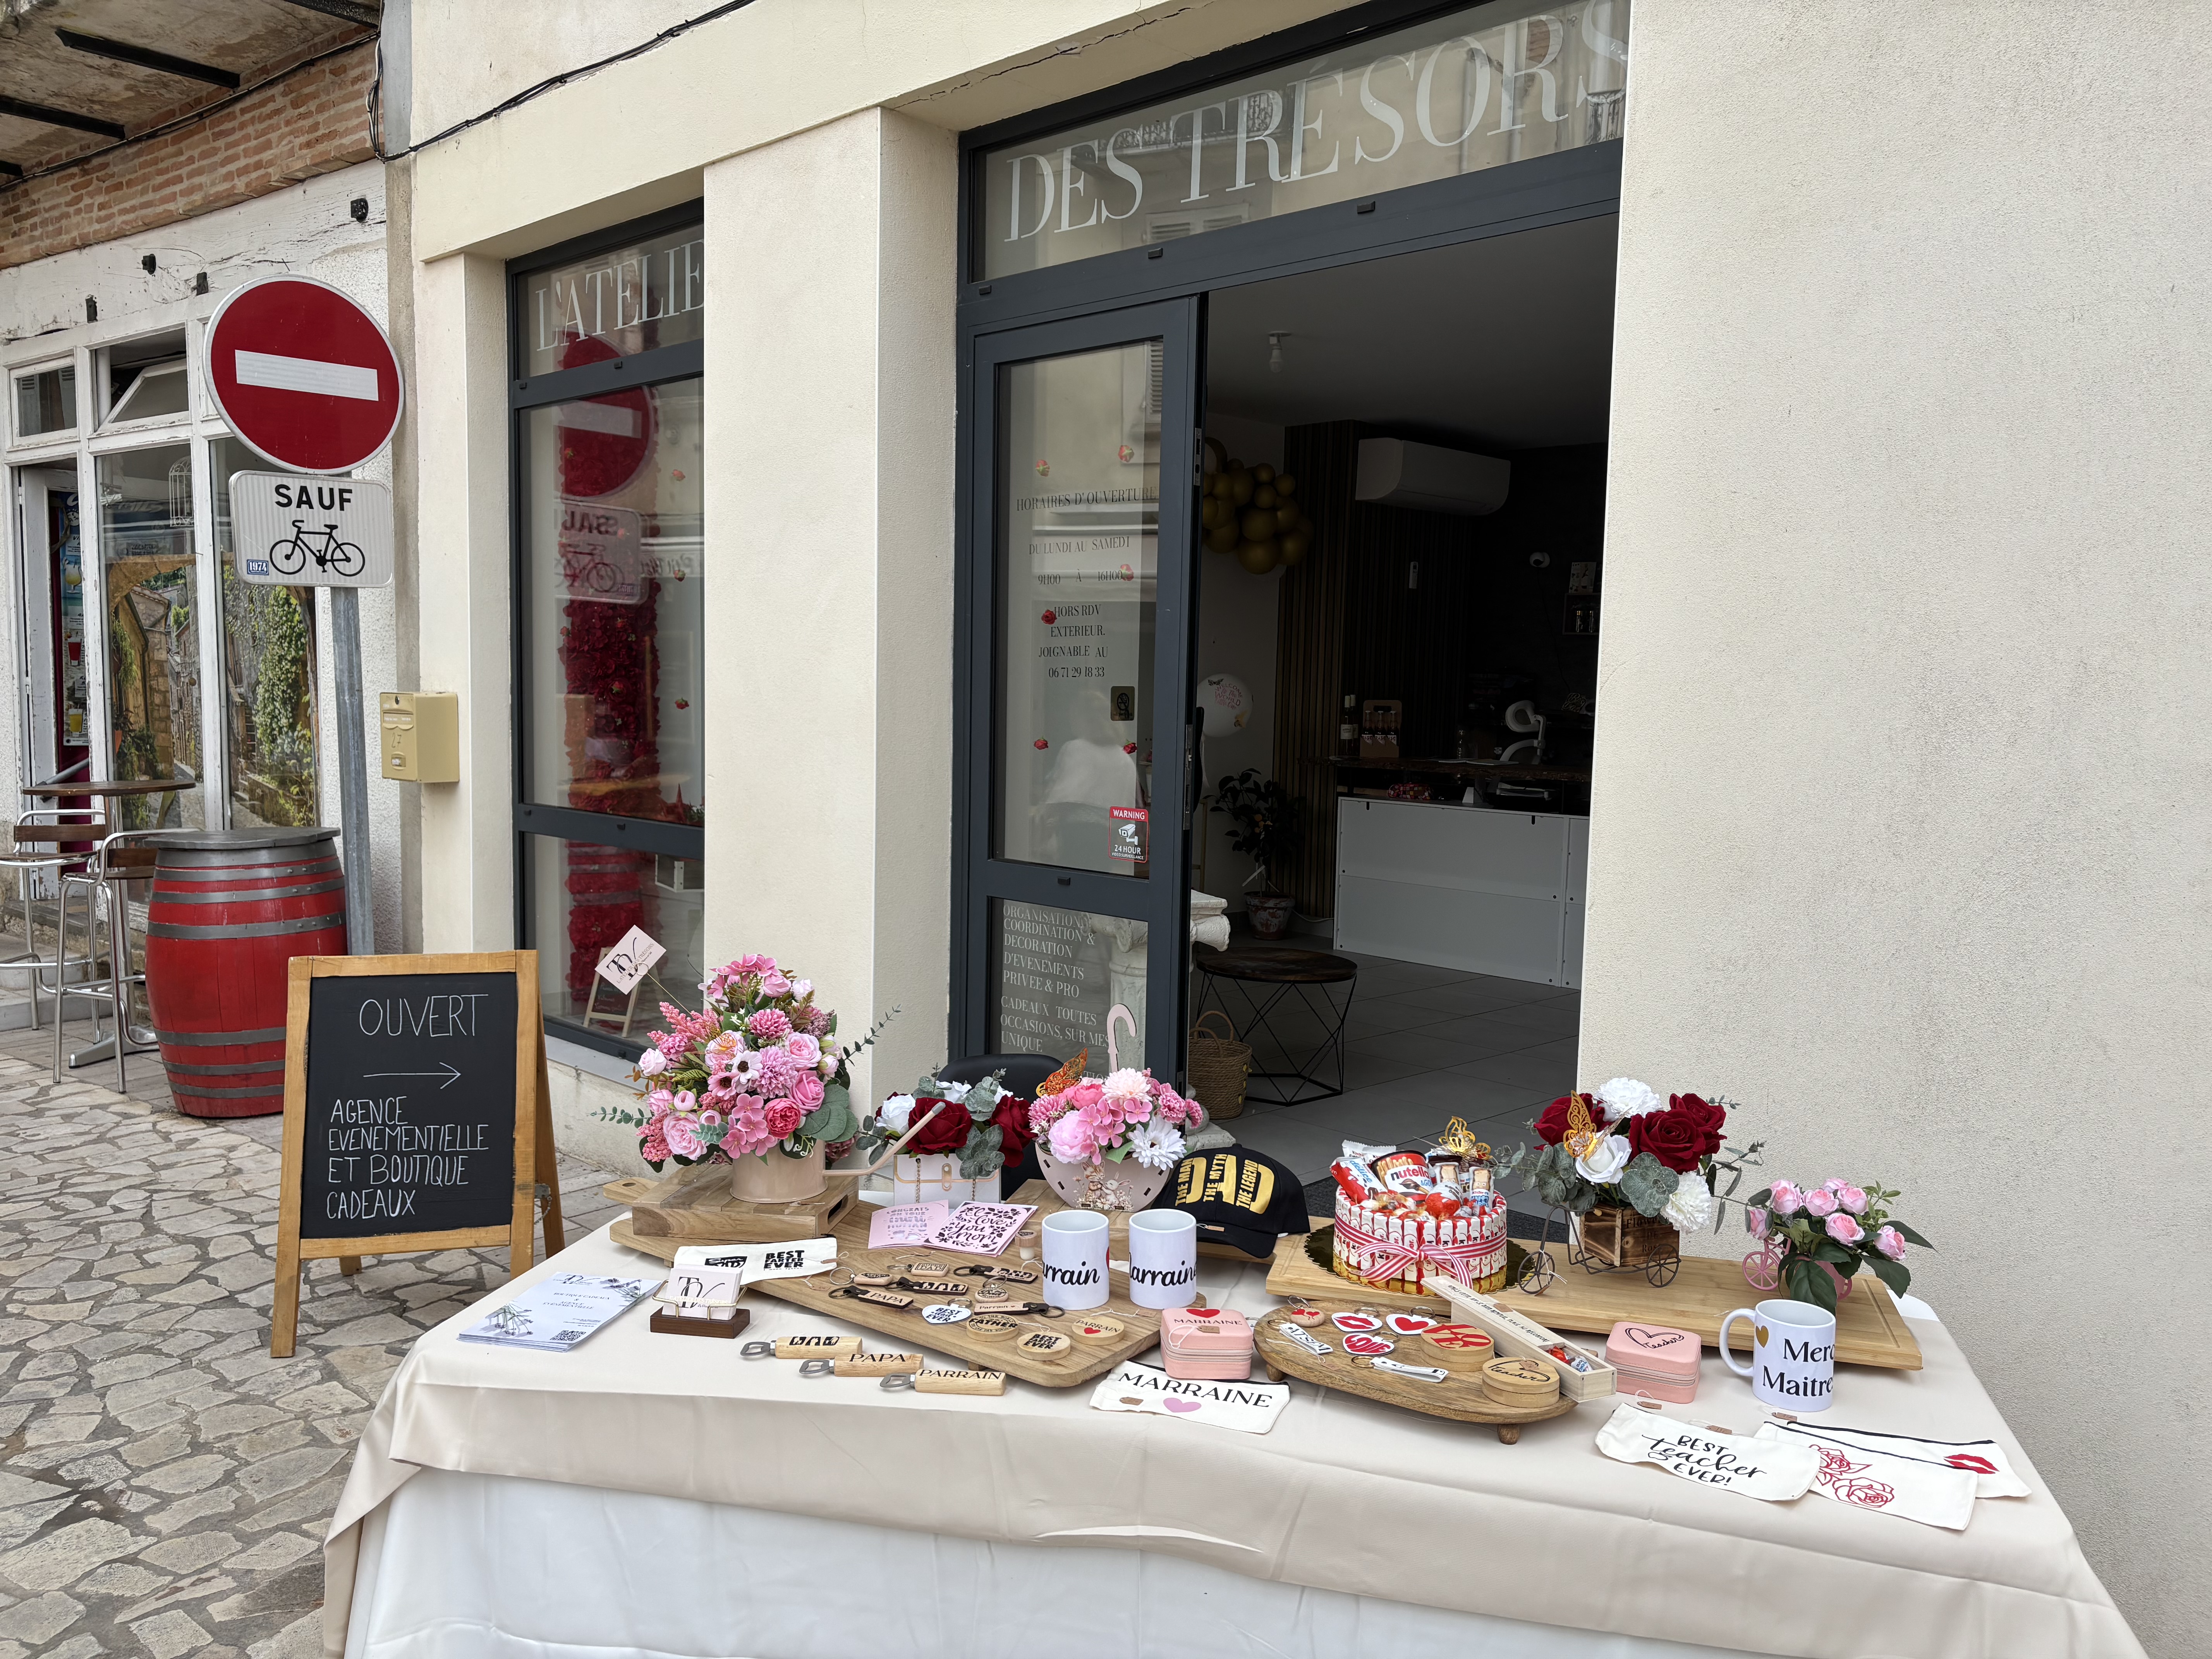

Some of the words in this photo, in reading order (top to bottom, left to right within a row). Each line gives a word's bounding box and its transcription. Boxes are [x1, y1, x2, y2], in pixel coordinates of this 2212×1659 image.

[1005, 128, 1143, 242] DES
[275, 484, 352, 511] SAUF
[1017, 494, 1070, 511] HORAIRES
[1029, 543, 1041, 555] DU
[1044, 542, 1071, 554] LUNDI
[1075, 541, 1087, 552] AU
[1092, 536, 1129, 550] SAMEDI
[1038, 574, 1060, 585] 9H00
[1054, 605, 1079, 617] HORS
[1082, 605, 1101, 616] RDV
[1051, 625, 1105, 637] EXTERIEUR.
[1039, 646, 1090, 658] JOIGNABLE
[1095, 647, 1108, 657] AU
[1048, 667, 1059, 678] 06
[1061, 667, 1069, 677] 71
[1071, 667, 1081, 677] 29
[1095, 666, 1104, 677] 33
[1113, 809, 1145, 820] WARNING
[1123, 846, 1141, 855] HOUR
[1003, 918, 1082, 942] COORDINATION
[1087, 932, 1096, 945] &
[1004, 934, 1073, 958] DECORATION
[1004, 951, 1084, 980] D'EVENEMENTS
[1003, 970, 1042, 990] PRIVEE
[1045, 979, 1054, 993] &
[1056, 981, 1079, 998] PRO
[359, 994, 489, 1037] OUVERT
[1001, 996, 1049, 1016] CADEAUX
[1056, 1006, 1097, 1025] TOUTES
[1000, 1014, 1063, 1040] OCCASIONS,
[1065, 1027, 1085, 1043] SUR
[1001, 1030, 1043, 1052] UNIQUE
[330, 1096, 409, 1125] AGENCE
[329, 1124, 489, 1151] EVENEMENTIELLE
[328, 1157, 361, 1183] ET
[370, 1154, 469, 1187] BOUTIQUE
[1178, 1158, 1194, 1183] MAN
[1209, 1154, 1228, 1180] MYTH
[1241, 1159, 1259, 1192] LEGEND
[1391, 1165, 1431, 1182] nutella
[1175, 1183, 1188, 1206] THE
[1203, 1182, 1218, 1202] THE
[1236, 1189, 1253, 1209] THE
[326, 1189, 416, 1219] CADEAUX
[766, 1250, 805, 1259] BEST
[869, 1293, 904, 1304] PAPA
[926, 1314, 951, 1322] EVER
[935, 1307, 963, 1316] BEST
[969, 1318, 1018, 1328] FATHER
[1076, 1319, 1121, 1333] PARRAIN
[1023, 1340, 1053, 1349] EVER
[1029, 1334, 1062, 1342] BEST
[1286, 1327, 1331, 1352] ATSEM
[1644, 1334, 1681, 1349] Teacher
[849, 1353, 906, 1362] PAPA
[919, 1369, 1005, 1380] PARRAIN
[1491, 1365, 1540, 1382] Teacher
[1118, 1373, 1273, 1408] MARRAINE
[1677, 1434, 1729, 1455] BEST
[1641, 1433, 1768, 1480] teacher
[1673, 1462, 1730, 1487] EVER!
